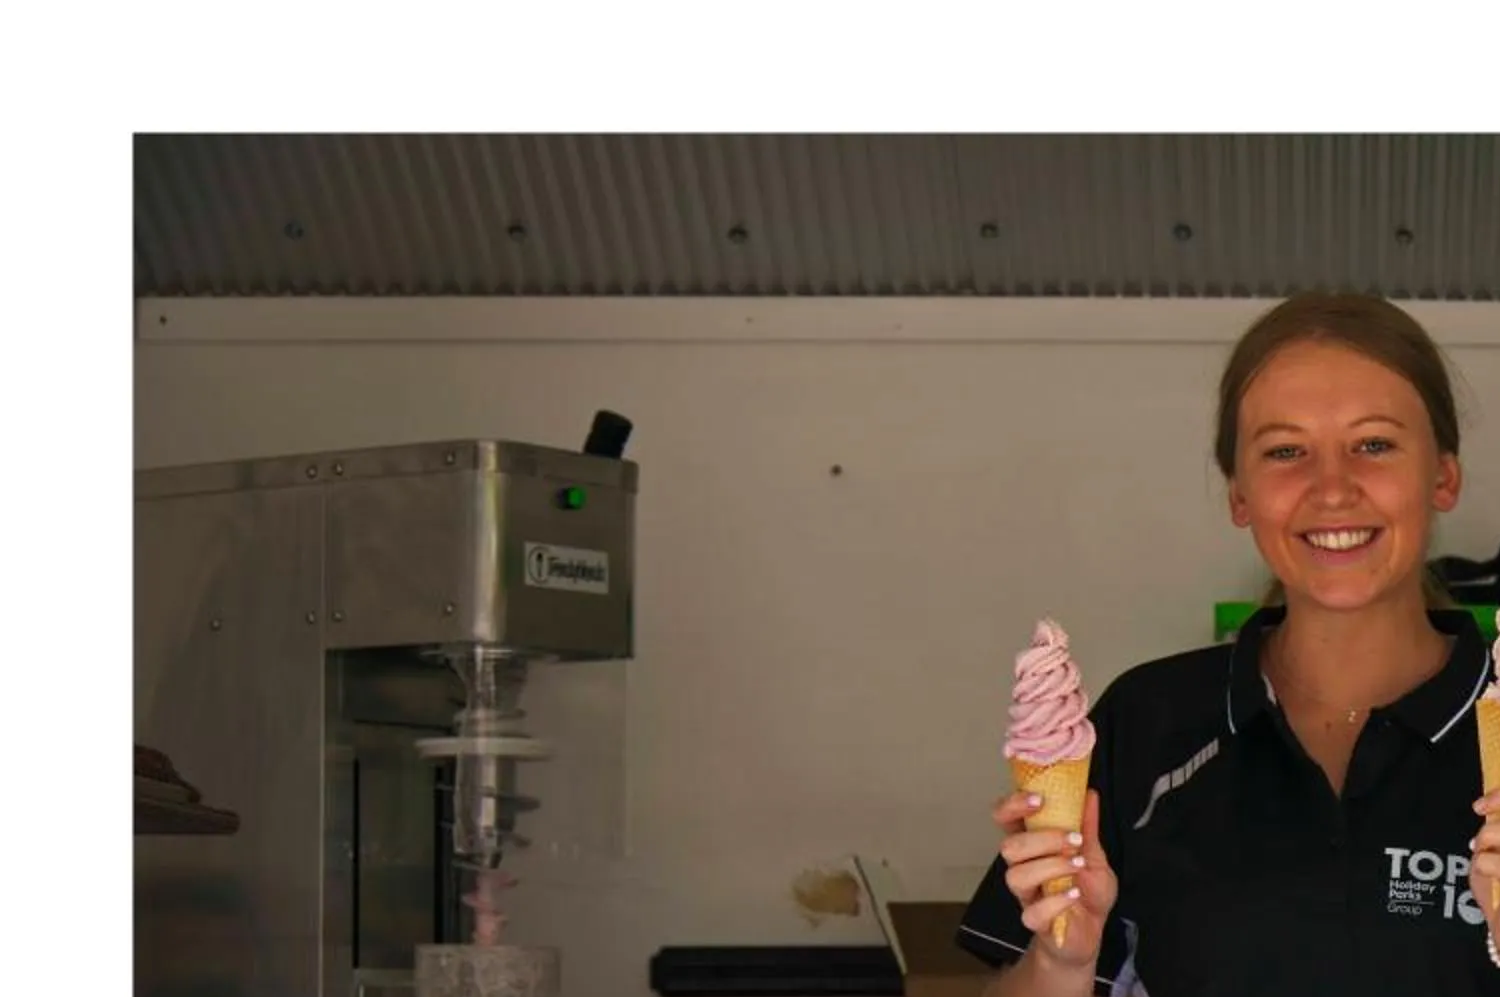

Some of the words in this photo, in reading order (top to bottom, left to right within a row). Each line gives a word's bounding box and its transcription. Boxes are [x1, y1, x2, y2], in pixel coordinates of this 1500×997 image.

[1384, 848, 1471, 884] TOP
[1389, 879, 1436, 895] Holiday
[1389, 889, 1422, 901] Parks
[1387, 903, 1423, 916] Group
